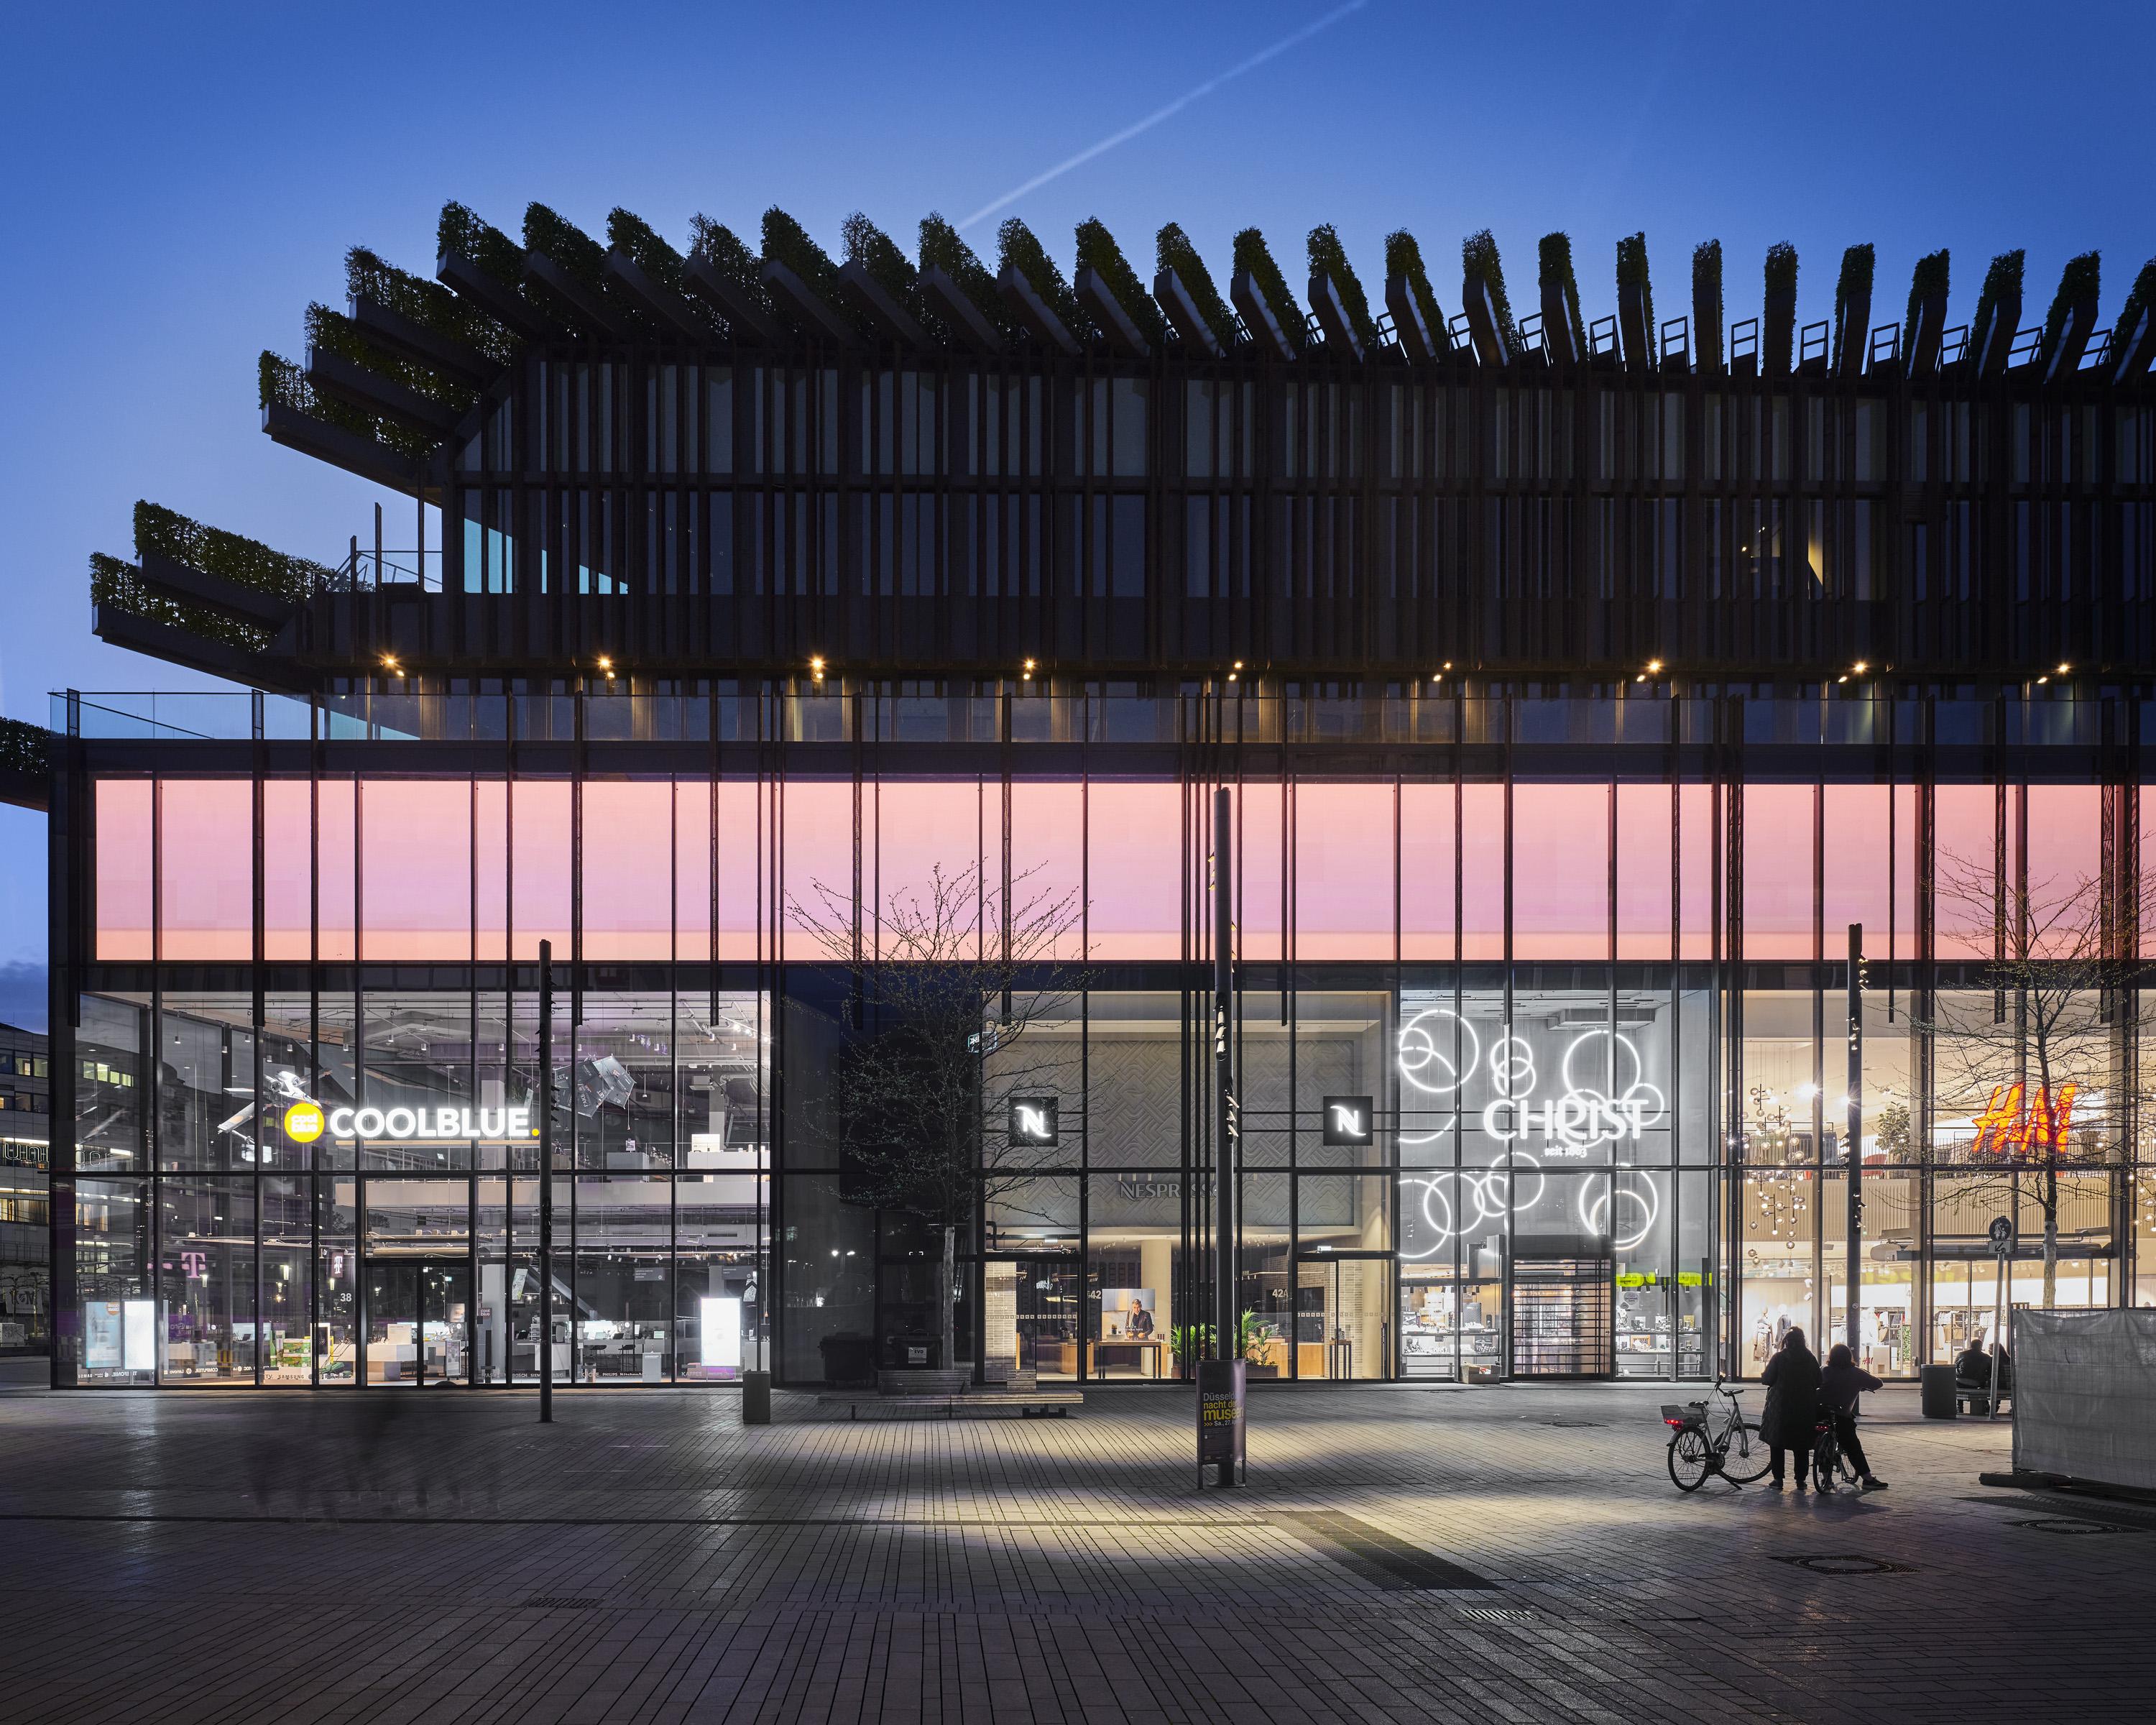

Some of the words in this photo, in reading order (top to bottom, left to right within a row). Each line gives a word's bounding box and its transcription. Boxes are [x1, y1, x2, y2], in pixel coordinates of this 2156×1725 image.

[290, 1113, 318, 1123] cool
[1483, 1099, 1649, 1140] CHRIST
[1972, 1083, 2077, 1154] H&M
[290, 1122, 318, 1133] blue
[1544, 1146, 1563, 1156] seit
[340, 1293, 352, 1302] 38
[1090, 1290, 1102, 1299] 42
[1272, 1289, 1289, 1298] 42A
[1203, 1400, 1227, 1409] nacht
[1227, 1399, 1238, 1408] der
[1203, 1407, 1243, 1421] museen
